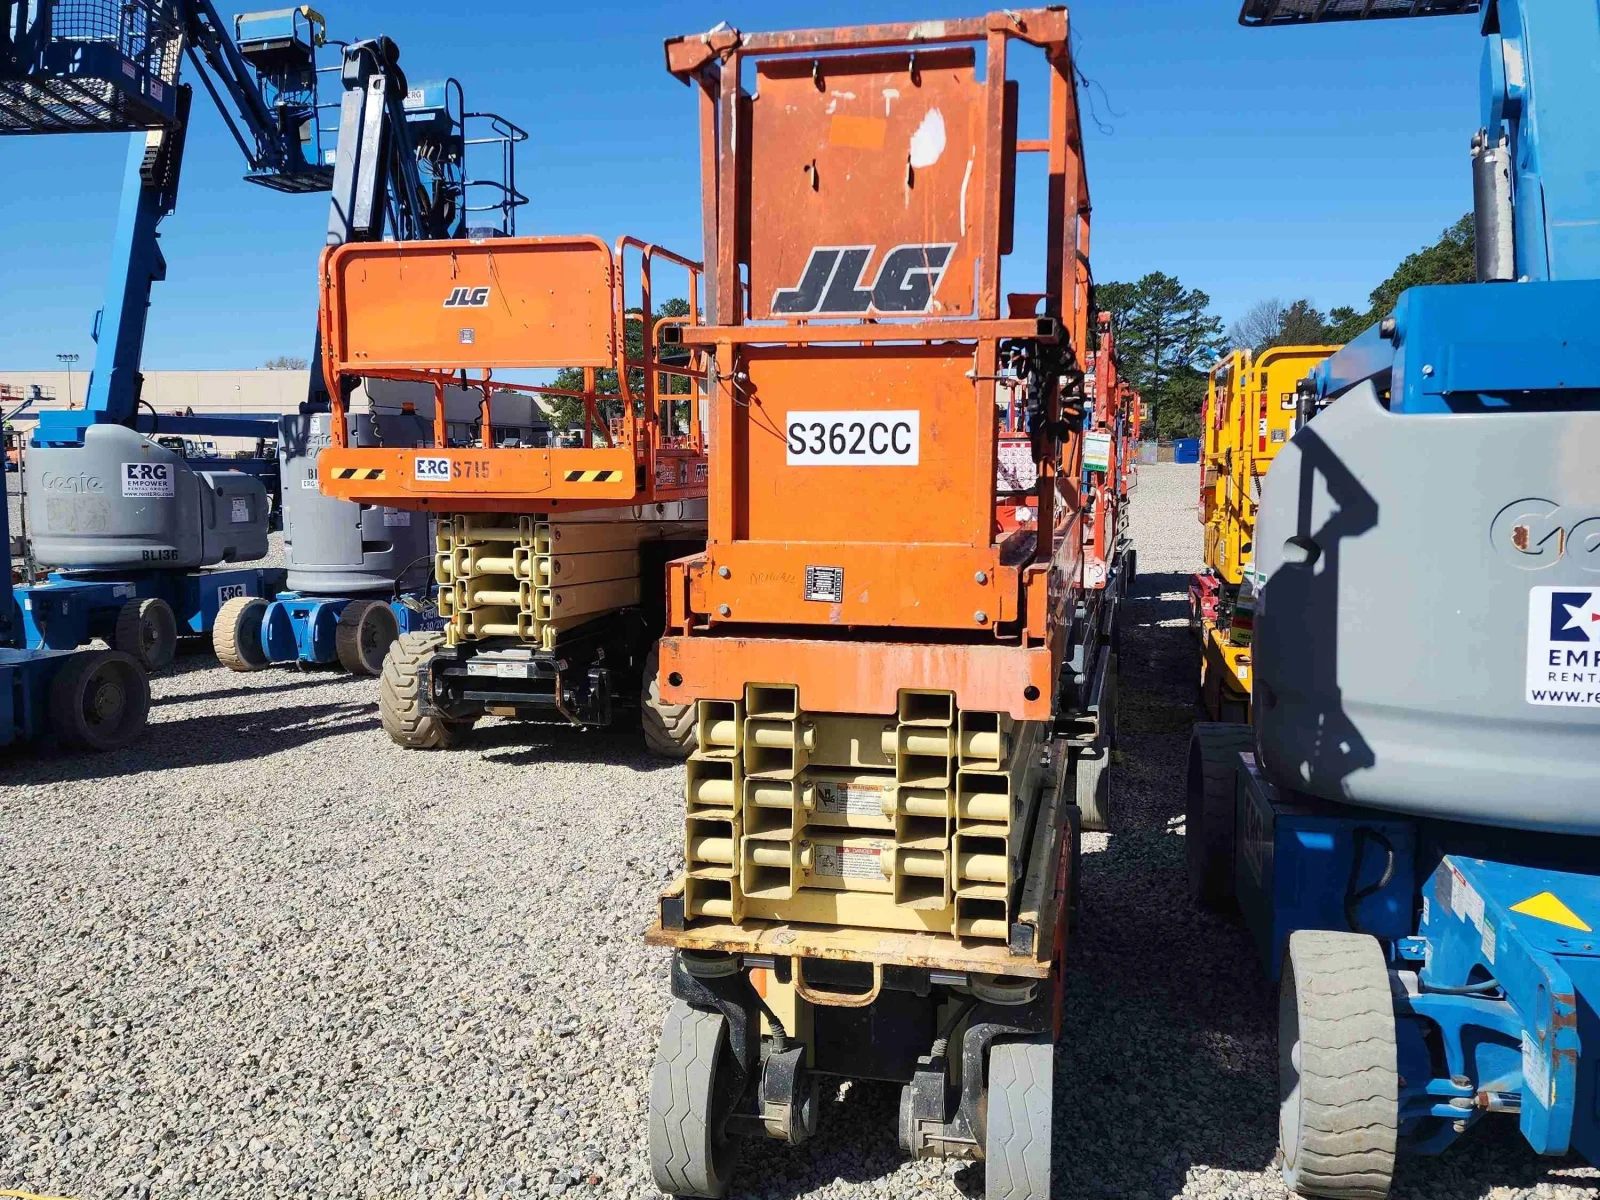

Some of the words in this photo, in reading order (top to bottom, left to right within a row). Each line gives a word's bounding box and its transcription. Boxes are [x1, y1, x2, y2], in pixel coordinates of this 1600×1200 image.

[771, 243, 957, 314] JLG
[443, 287, 491, 307] JLG
[787, 422, 911, 455] S362CC
[127, 464, 167, 480] ERG
[417, 459, 449, 475] ERG
[452, 460, 490, 479] S715
[41, 471, 106, 494] Genie
[220, 585, 244, 602] ERG
[421, 607, 439, 621] Geni
[1548, 671, 1600, 684] RENT
